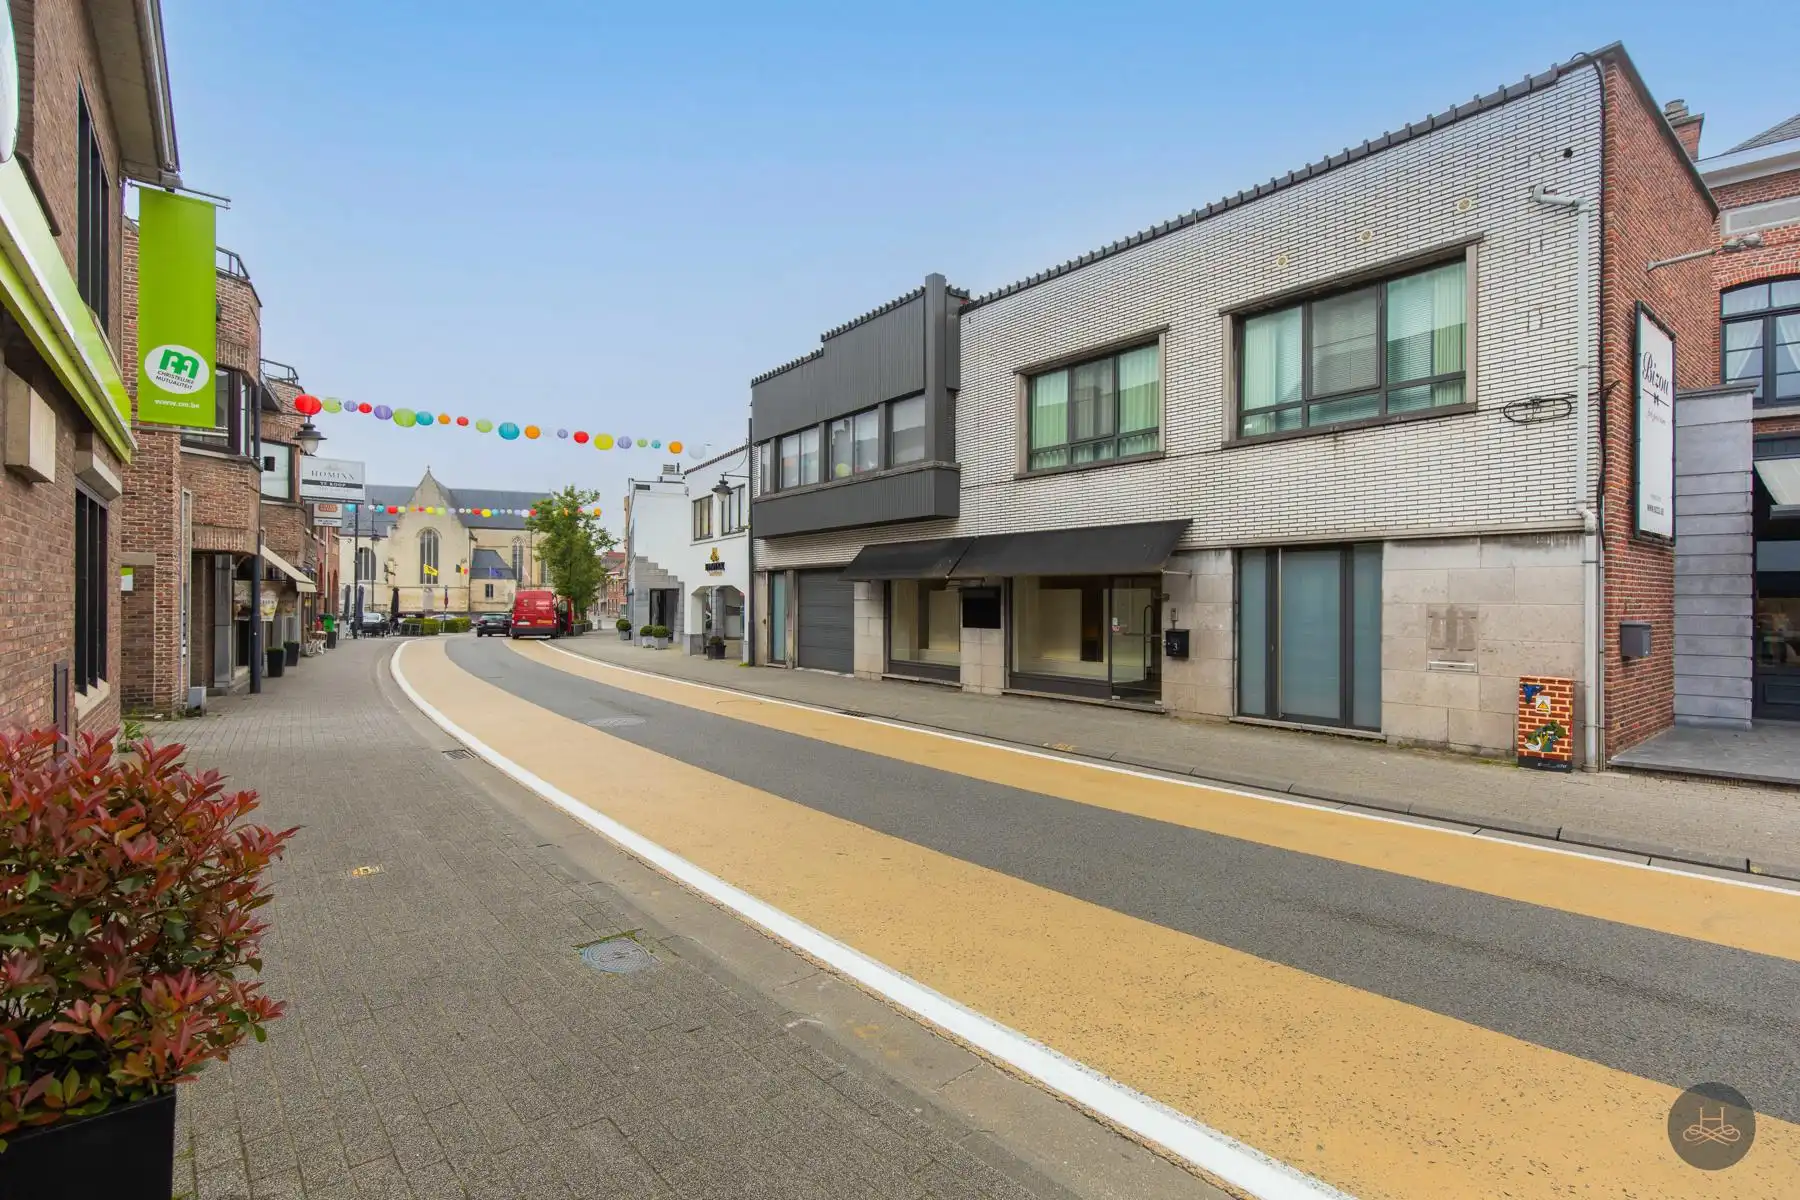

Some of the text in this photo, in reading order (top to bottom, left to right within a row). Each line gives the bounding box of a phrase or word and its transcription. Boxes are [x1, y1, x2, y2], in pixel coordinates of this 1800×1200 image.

[1642, 351, 1669, 396] Bizou
[155, 375, 193, 390] MUTUALITEIT
[154, 399, 200, 409] www.cm.be
